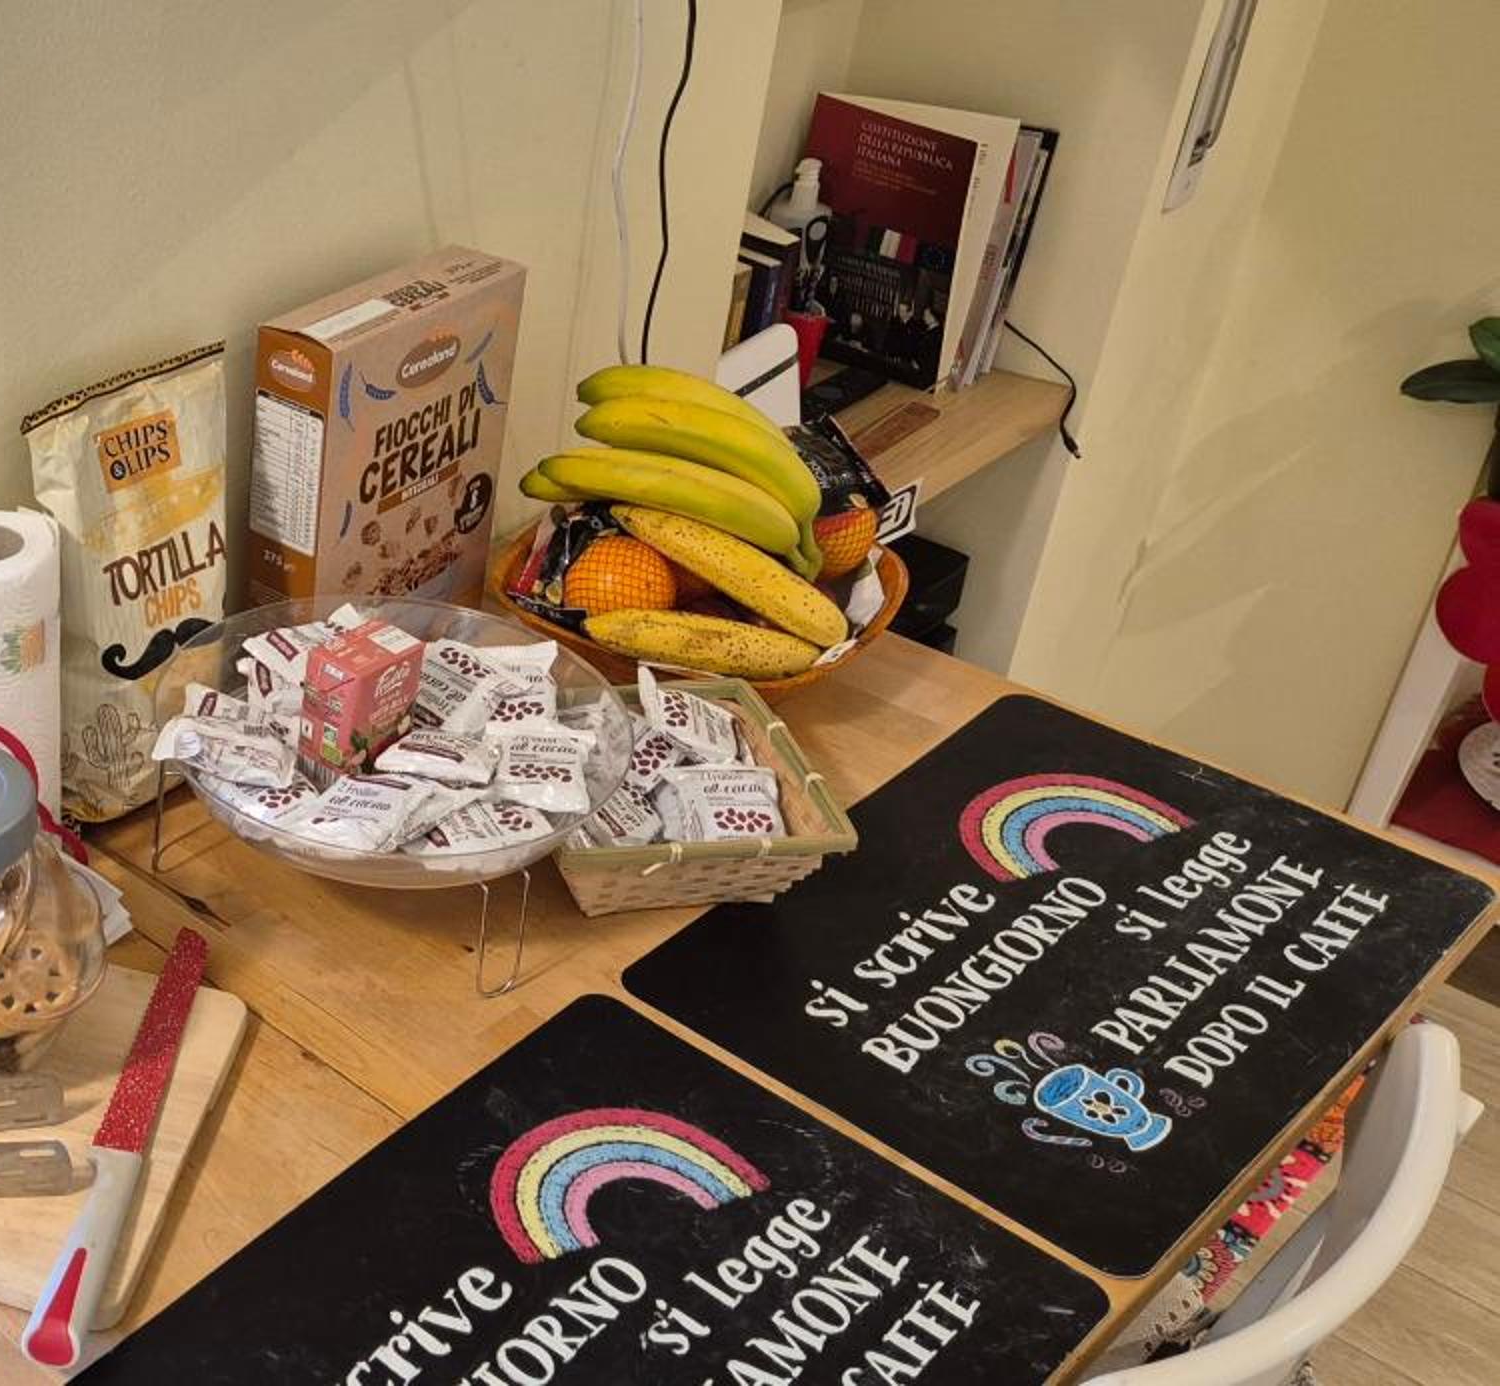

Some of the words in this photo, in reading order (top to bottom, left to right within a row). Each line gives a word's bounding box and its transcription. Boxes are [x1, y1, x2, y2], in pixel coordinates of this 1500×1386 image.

[401, 337, 457, 380] Cerealand
[103, 419, 168, 458] CHIPS
[127, 441, 171, 476] LIPS
[358, 409, 481, 504] CEREALI
[373, 396, 451, 457] FIOCCHI
[457, 381, 477, 414] DI
[102, 519, 228, 606] TORTILLA
[143, 577, 201, 628] CHIPS
[1136, 831, 1252, 910] legge
[804, 979, 869, 1028] si
[853, 883, 996, 989] scrive
[1090, 855, 1324, 1055] PARLIAMONE
[1115, 903, 1168, 941] si
[861, 877, 1107, 1074] BUONGIORNO
[1163, 1004, 1269, 1088] DOPO
[1245, 975, 1306, 1010] IL
[1283, 883, 1390, 972] CAFFÈ
[648, 1299, 712, 1356] si
[683, 1199, 831, 1310] legge
